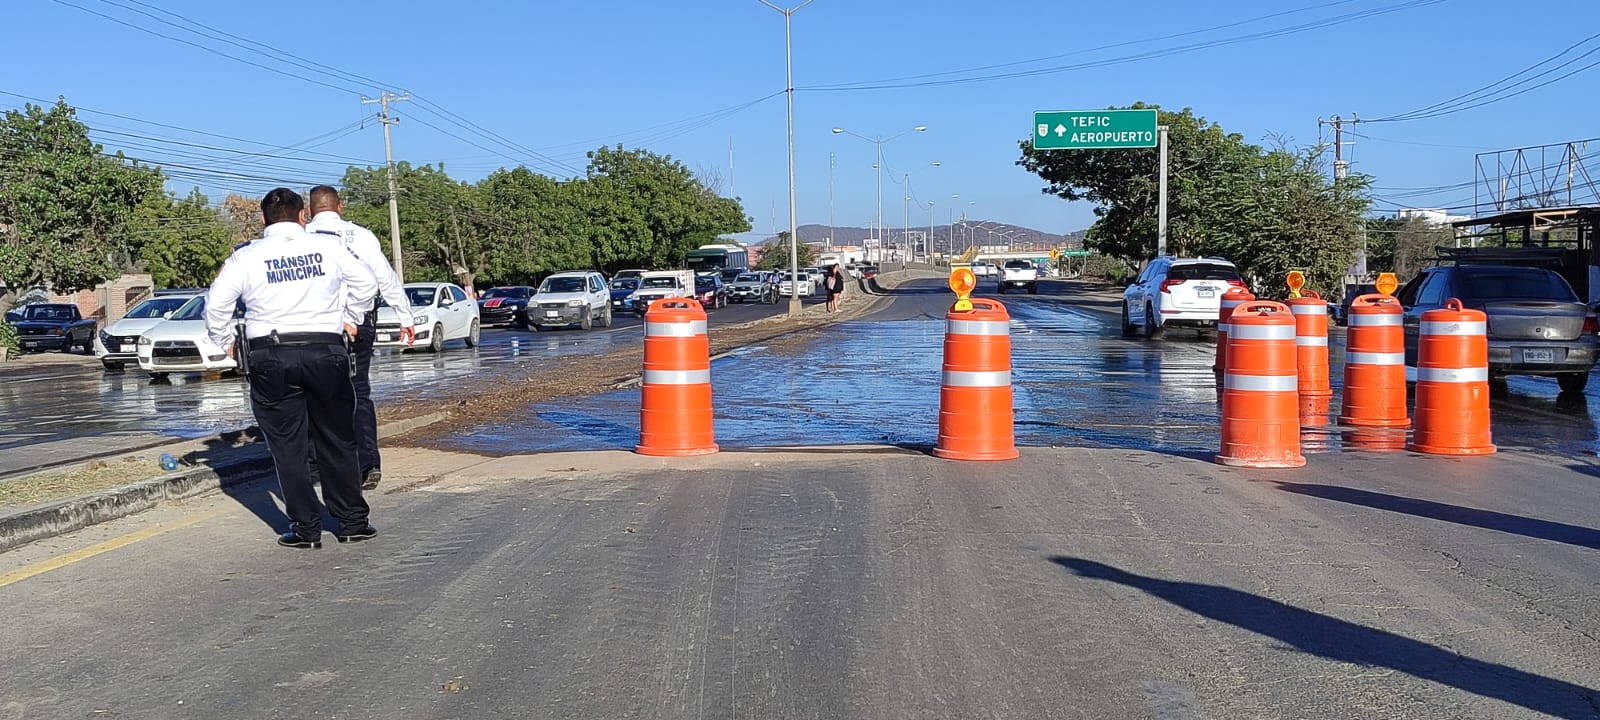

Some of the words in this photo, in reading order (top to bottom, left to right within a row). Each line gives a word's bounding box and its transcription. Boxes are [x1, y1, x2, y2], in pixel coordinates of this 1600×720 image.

[1071, 131, 1153, 143] AEROPUERTO
[265, 252, 323, 271] TRÁNSITO
[266, 264, 325, 284] MUNICIPAL
